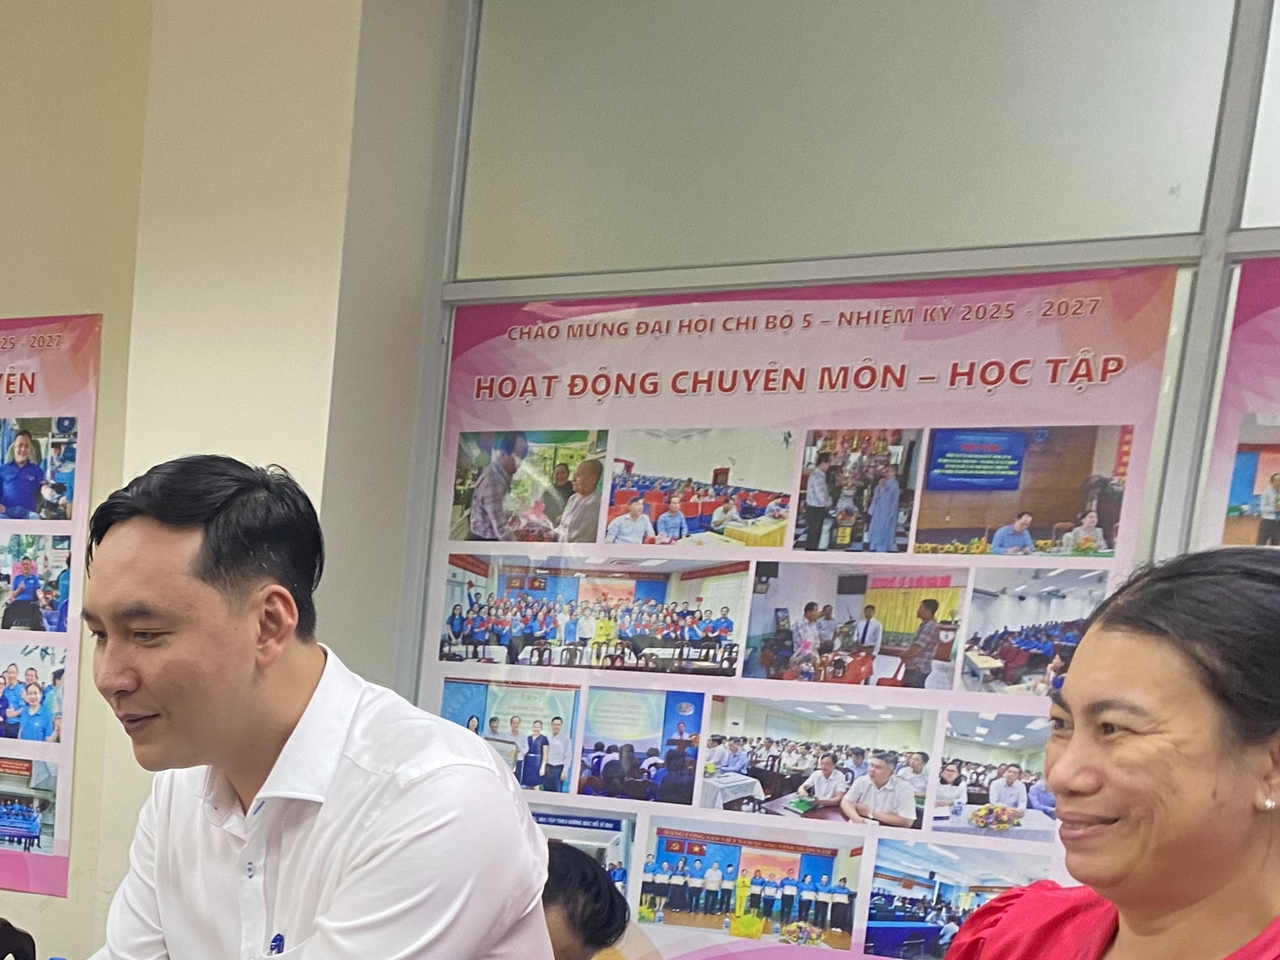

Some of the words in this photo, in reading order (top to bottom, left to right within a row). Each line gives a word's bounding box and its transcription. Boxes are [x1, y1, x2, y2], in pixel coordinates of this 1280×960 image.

[506, 320, 560, 341] CHÀO
[636, 320, 671, 341] ĐẠI
[678, 313, 715, 339] HỘI
[722, 316, 758, 332] CHI
[764, 308, 794, 335] BỘ
[801, 313, 813, 329] 5
[837, 304, 915, 331] NHIỆM
[960, 302, 1016, 321] 2025
[1041, 298, 1102, 318] 2027
[29, 334, 63, 349] 2027
[475, 374, 560, 405] HOẠT
[567, 366, 660, 404] ĐỘNG
[670, 361, 806, 394] CHUYÊN
[818, 357, 907, 390] MÔN
[948, 358, 1032, 394] HỌC
[1045, 347, 1125, 391] TẬP
